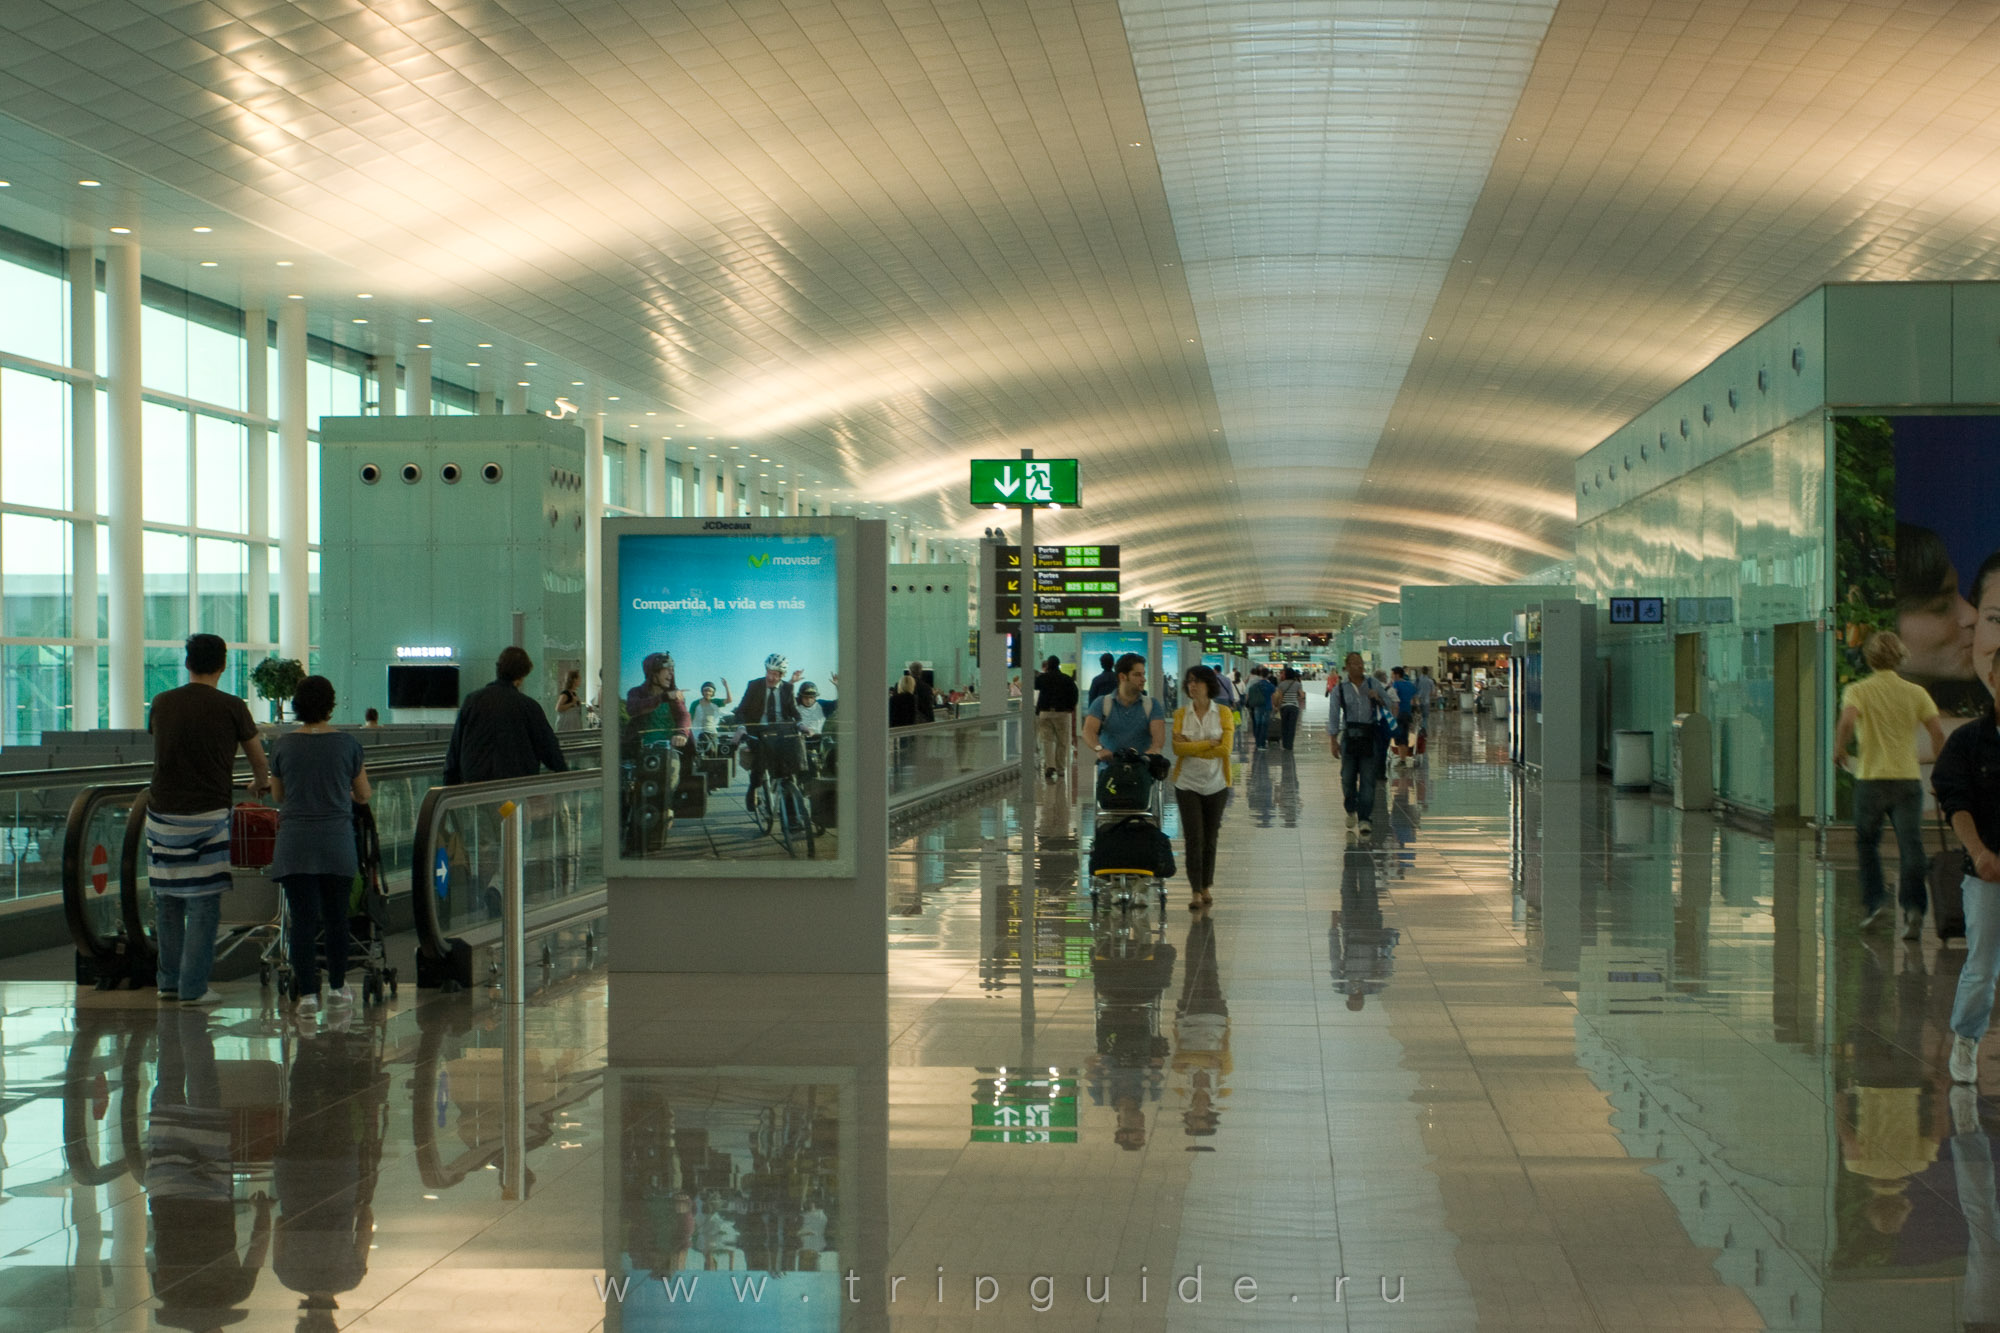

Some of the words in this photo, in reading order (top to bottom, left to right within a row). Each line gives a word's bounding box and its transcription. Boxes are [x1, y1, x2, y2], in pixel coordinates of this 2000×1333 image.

[702, 521, 751, 530] JCDecaux
[773, 556, 821, 565] movistar
[632, 598, 711, 612] Compartida,
[714, 598, 725, 610] la
[728, 598, 756, 610] vida
[759, 602, 774, 610] es
[777, 597, 806, 610] más
[396, 646, 452, 657] SAMSUNG
